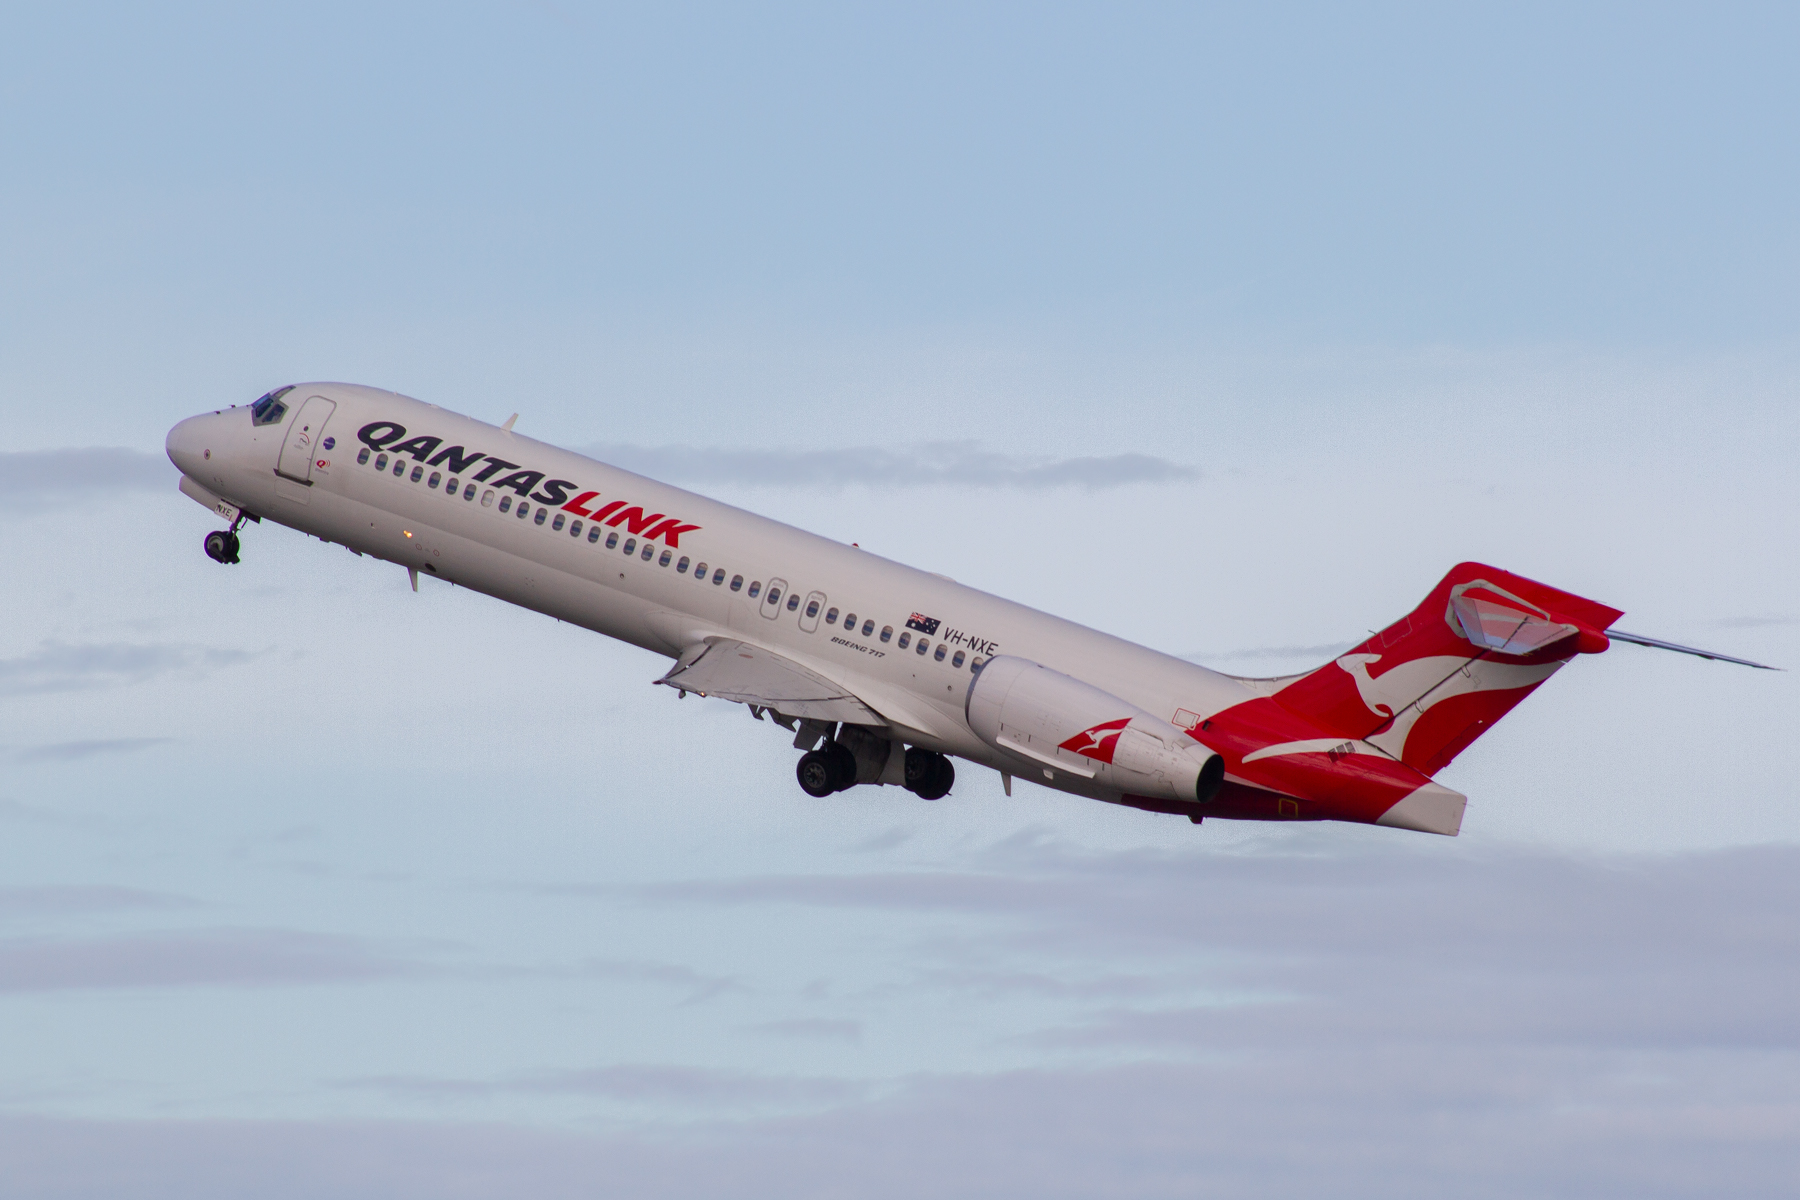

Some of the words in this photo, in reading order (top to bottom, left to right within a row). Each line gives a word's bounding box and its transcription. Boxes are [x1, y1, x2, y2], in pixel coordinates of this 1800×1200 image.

[357, 421, 702, 549] QANTASLINK
[216, 504, 232, 517] NXE
[831, 636, 867, 652] BOEING
[868, 648, 885, 658] 717
[943, 627, 999, 657] VH-NXE
